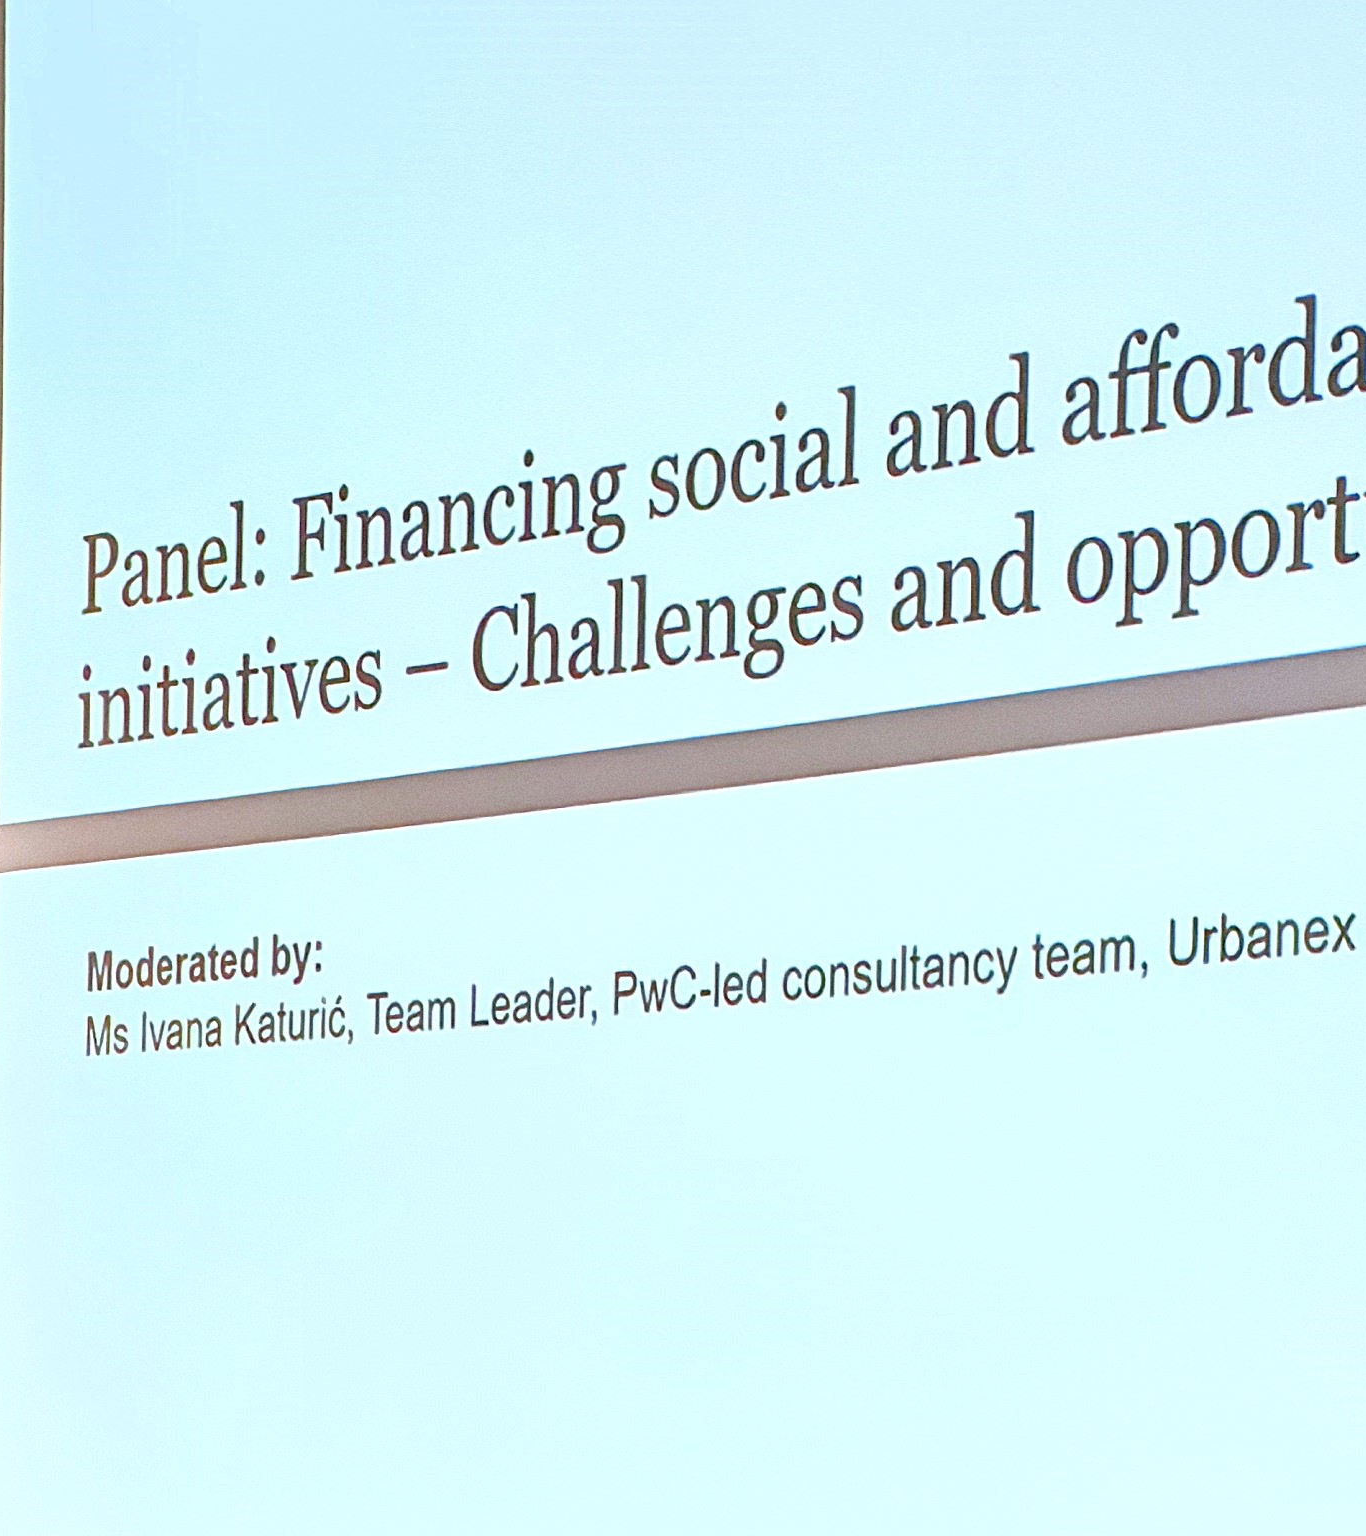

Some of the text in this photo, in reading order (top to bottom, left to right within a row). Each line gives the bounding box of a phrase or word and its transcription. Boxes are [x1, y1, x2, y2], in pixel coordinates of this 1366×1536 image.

[82, 500, 265, 614] Panel:
[291, 450, 626, 580] Financing
[649, 386, 859, 519] social
[887, 352, 1034, 477] and
[79, 637, 381, 748] initiatives
[473, 575, 863, 691] Challenges
[892, 510, 1040, 631] and
[87, 1015, 128, 1056] Ms
[142, 1012, 221, 1052] Ivana
[235, 995, 353, 1045] Katurić,
[367, 992, 455, 1034] Team
[471, 977, 597, 1026] Leader,
[614, 958, 767, 1015] PwC-led
[783, 945, 1017, 1000] consultancy
[1032, 935, 1147, 979] team,
[1170, 913, 1356, 966] Urbanex
[88, 934, 322, 992] Moderated by:
